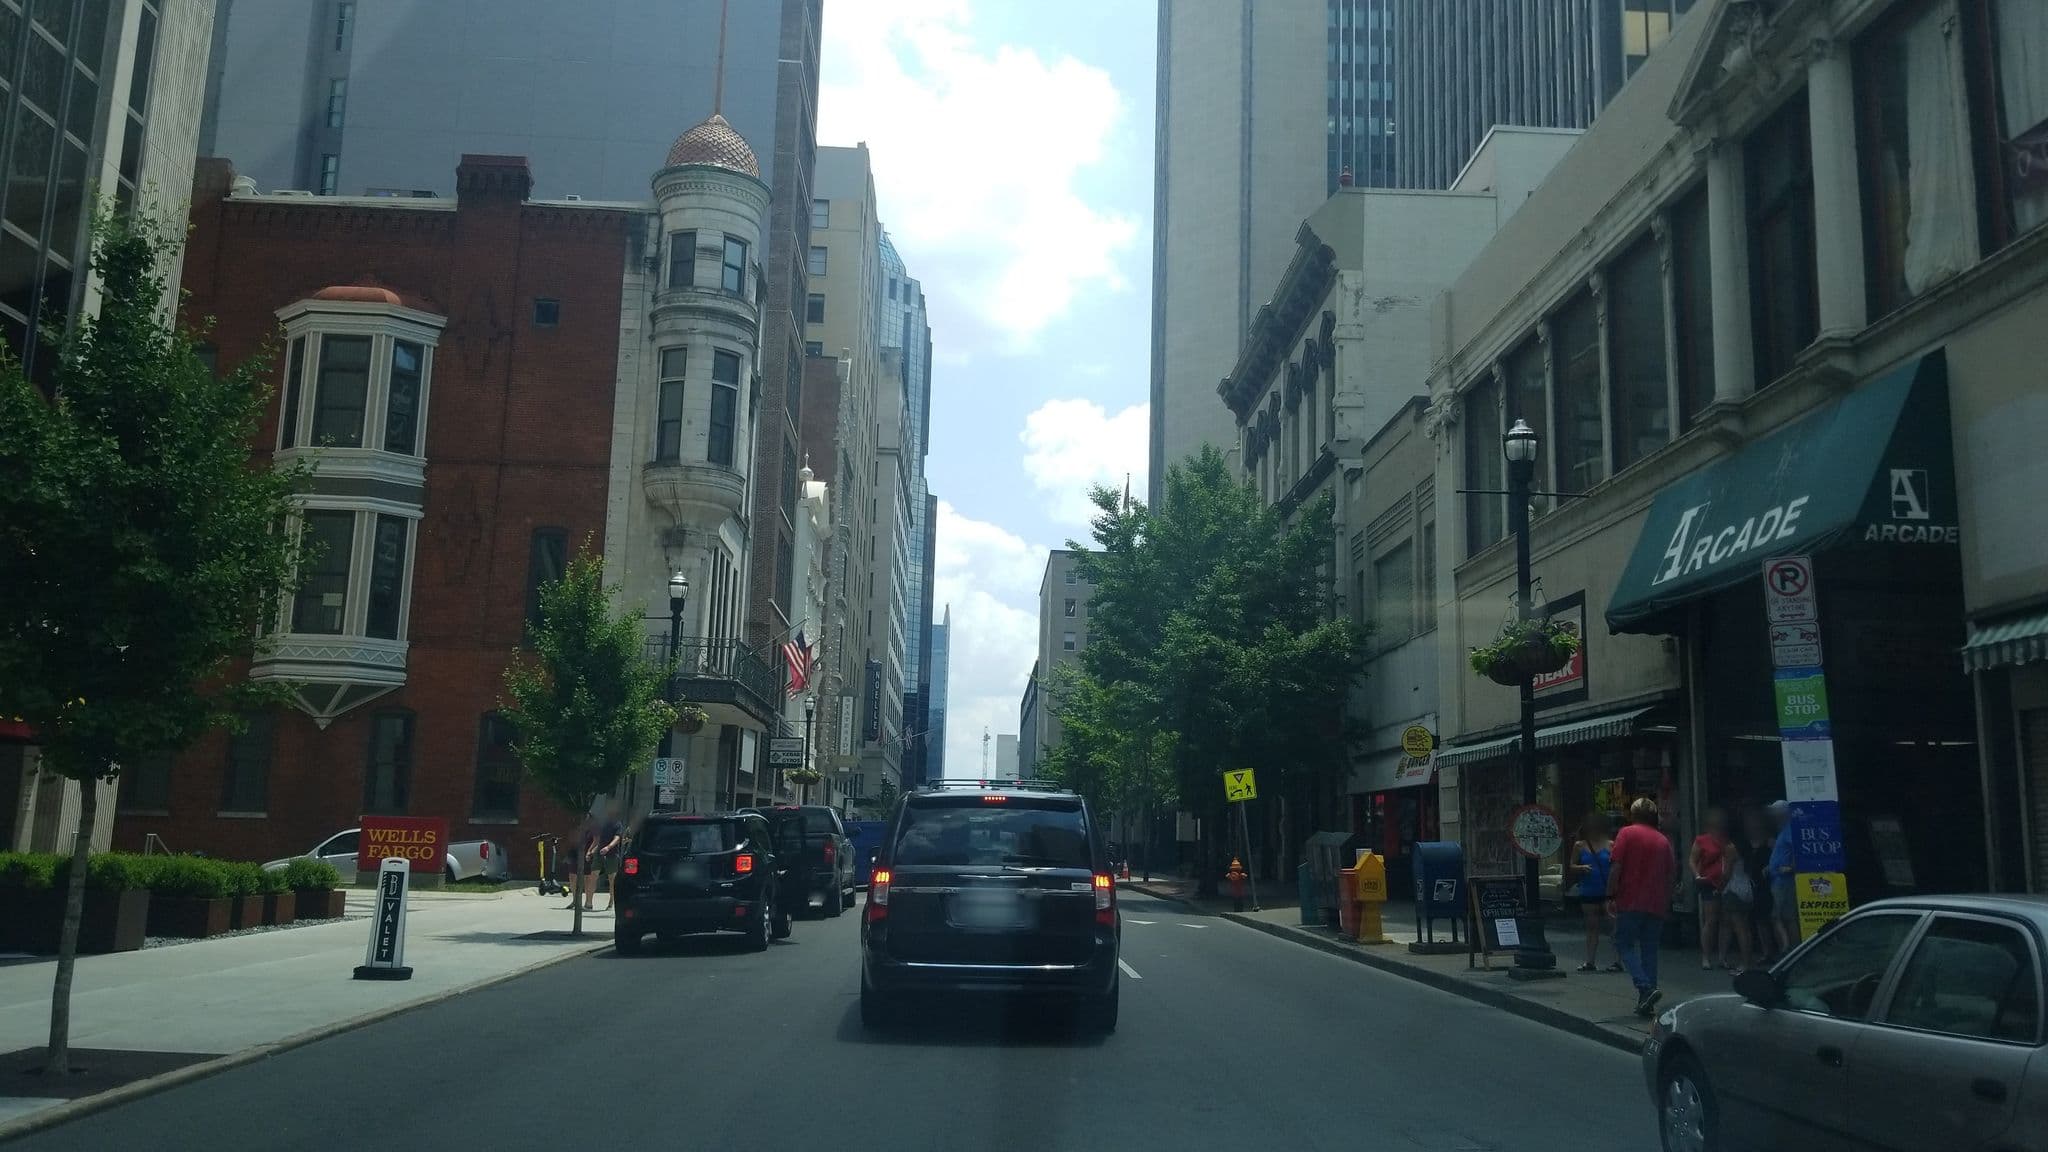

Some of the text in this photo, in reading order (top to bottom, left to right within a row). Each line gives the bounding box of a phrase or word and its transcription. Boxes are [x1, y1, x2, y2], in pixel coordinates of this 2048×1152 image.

[1652, 496, 1810, 587] ARCADE
[1865, 523, 1959, 545] ARCADE
[872, 671, 881, 730] NOELLE
[1787, 694, 1816, 705] BUS
[1784, 704, 1821, 715] STOP
[367, 828, 436, 844] WELLS
[1800, 828, 1830, 841] BUS
[367, 844, 435, 860] FARGO
[1801, 841, 1841, 855] STOP
[1800, 900, 1847, 909] EXPRESS
[381, 902, 395, 957] VALET
